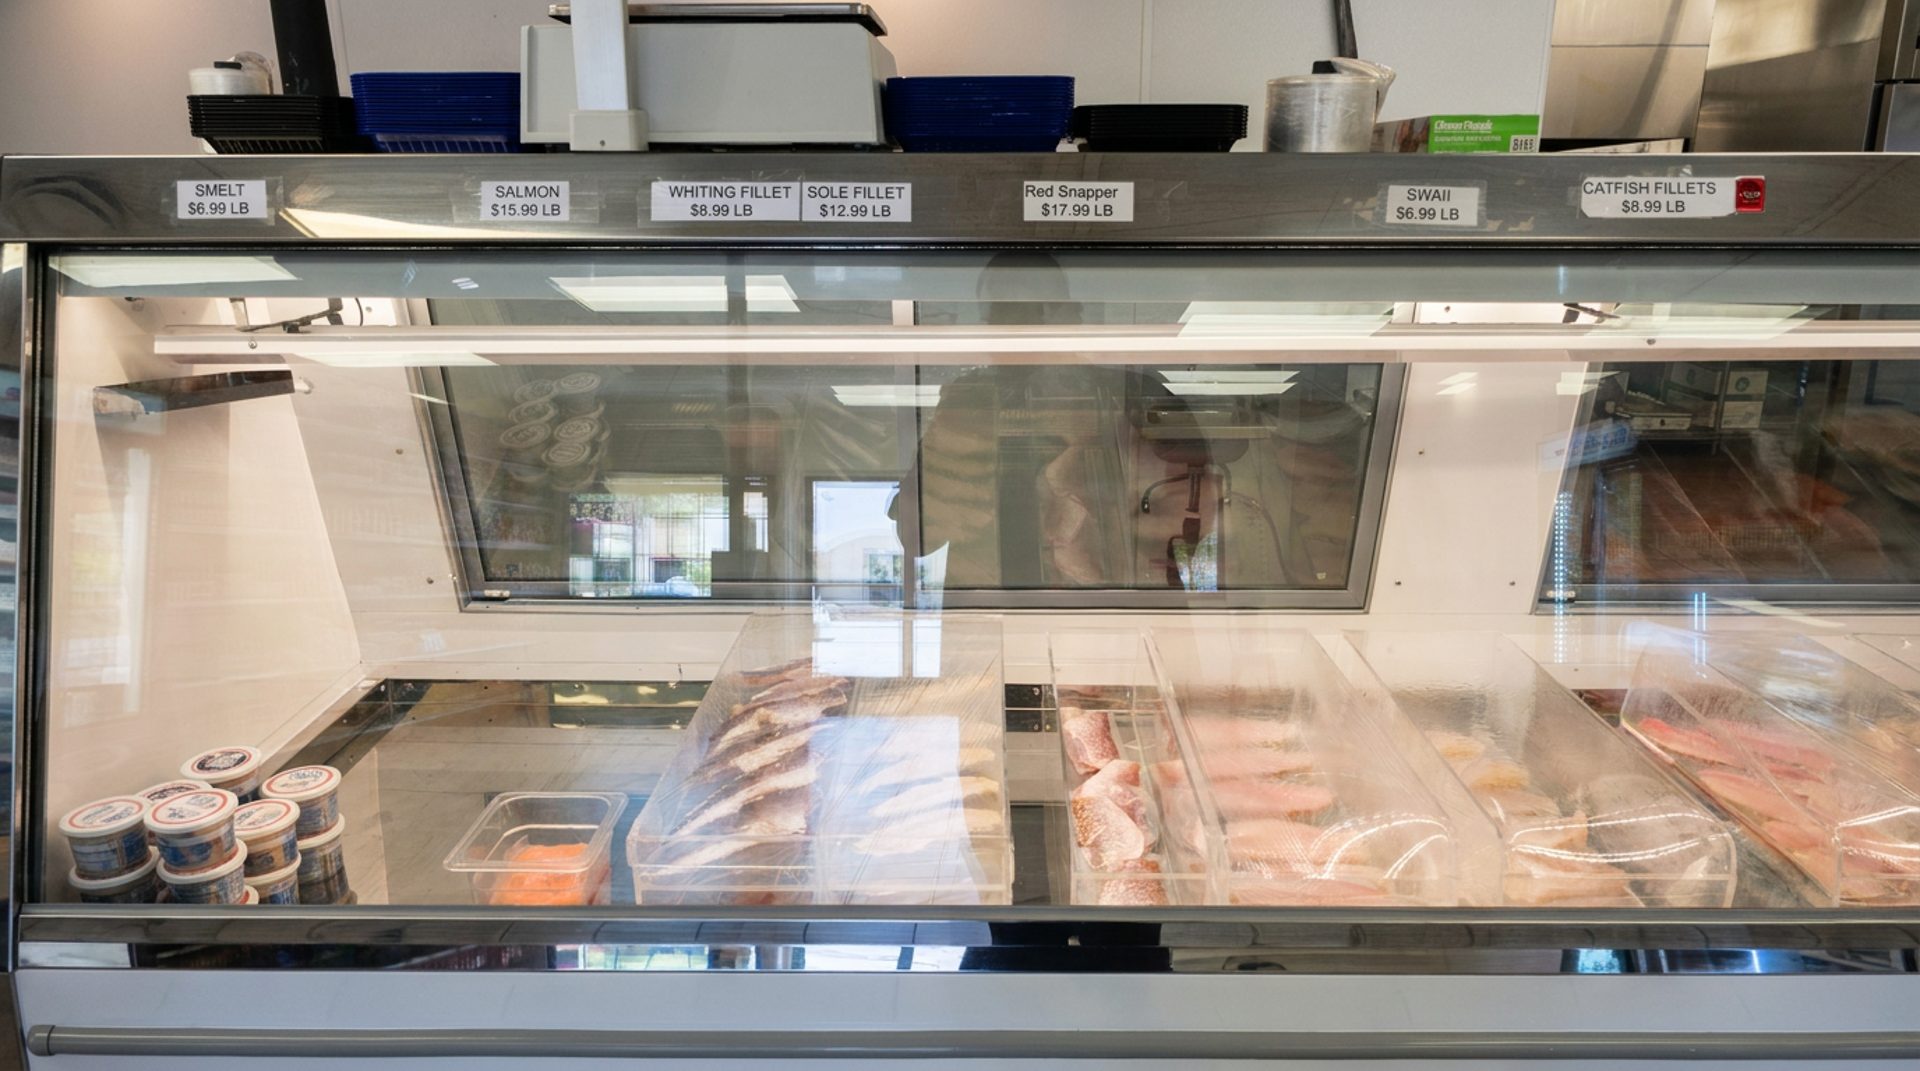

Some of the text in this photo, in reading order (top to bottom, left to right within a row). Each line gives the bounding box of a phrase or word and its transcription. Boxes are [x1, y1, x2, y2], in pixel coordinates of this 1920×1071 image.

[195, 183, 245, 198] SMELT
[495, 185, 560, 199] SALMON
[669, 185, 792, 199] WHITING FILLET
[807, 185, 905, 200] SOLE FILLET
[1025, 184, 1119, 202] Red Snapper
[1583, 181, 1716, 195] CATFISH FILLETS
[188, 201, 250, 216] $6.99 LB
[491, 203, 561, 217] $15.99 LB
[690, 203, 753, 217] $8.99 LB
[819, 203, 892, 218] $12.99 LB
[1041, 203, 1114, 217] $17.99 LB
[1396, 206, 1459, 221] $6.99 LB
[1621, 199, 1686, 214] $8.99 LB
